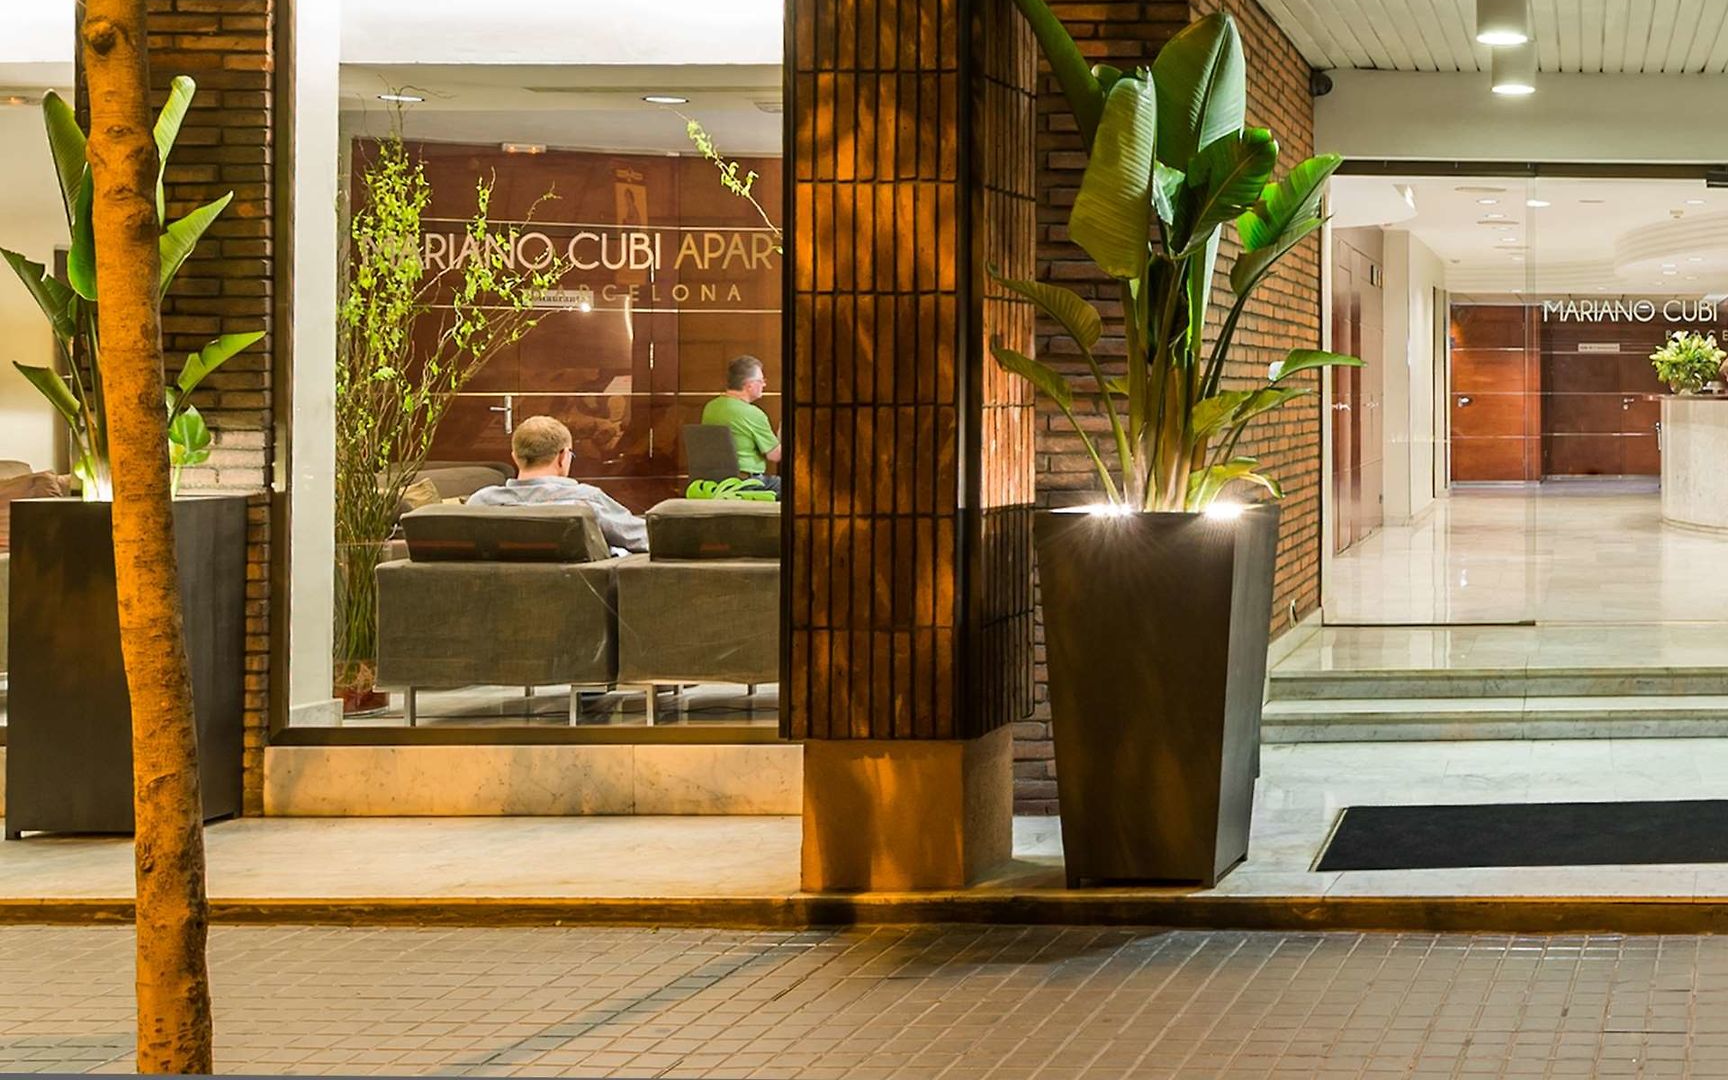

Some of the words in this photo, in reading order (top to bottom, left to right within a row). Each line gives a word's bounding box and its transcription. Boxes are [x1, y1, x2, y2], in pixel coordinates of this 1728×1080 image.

[361, 232, 554, 270] MARIANO
[567, 232, 661, 270] CUBI
[674, 232, 777, 270] APAR
[1543, 300, 1655, 322] MARIANO
[1663, 300, 1717, 322] CUBI
